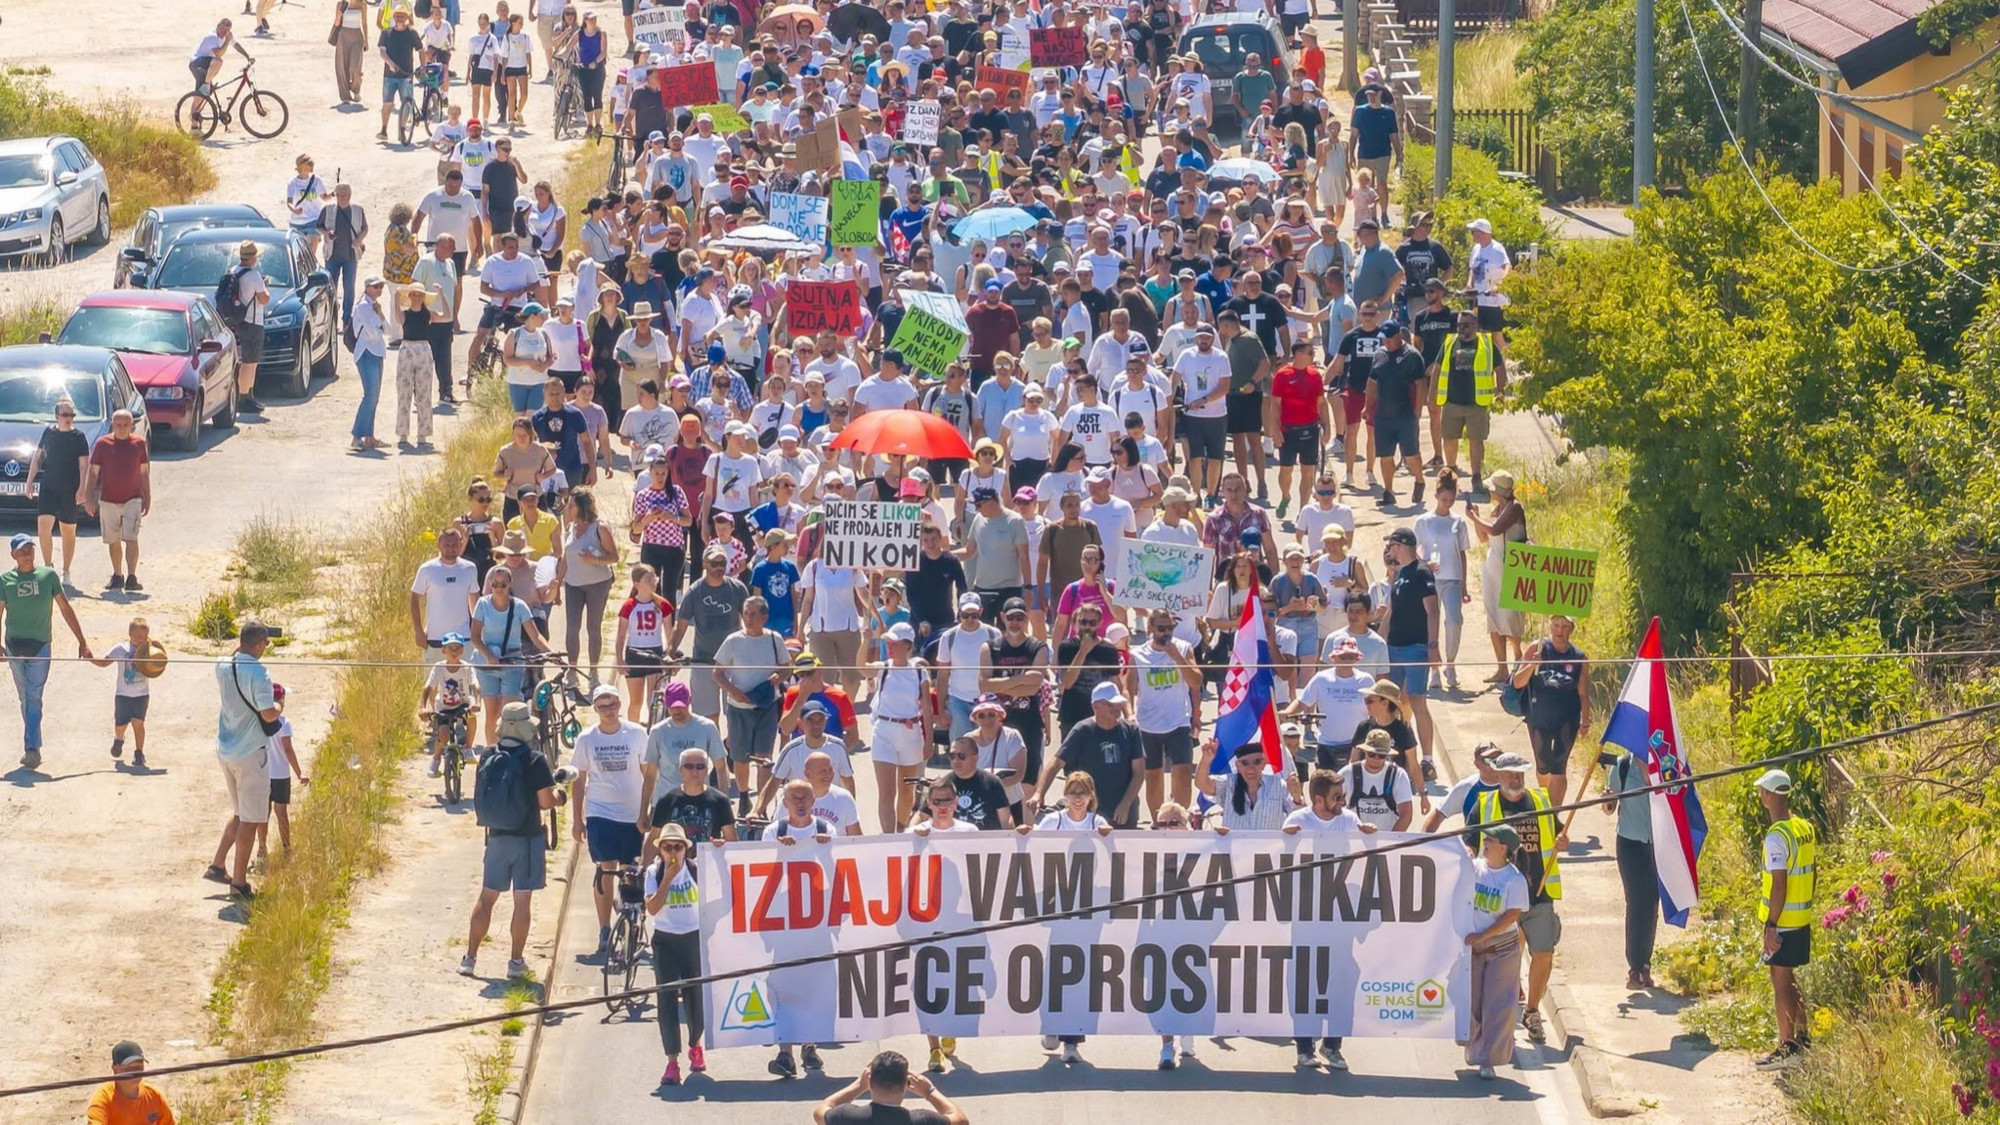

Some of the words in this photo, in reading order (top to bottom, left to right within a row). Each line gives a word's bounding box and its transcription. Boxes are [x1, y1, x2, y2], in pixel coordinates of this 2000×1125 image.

[772, 194, 797, 210] DOM
[805, 197, 826, 215] SE
[788, 209, 806, 225] NE
[836, 231, 878, 243] SLOBODA
[790, 311, 852, 333] IZDAJA
[908, 306, 963, 349] PRIRODA
[912, 330, 947, 356] NEMA
[1076, 423, 1090, 434] DO
[1079, 413, 1101, 423] JUST
[861, 503, 878, 520] SE
[883, 504, 921, 521] LIKOM
[824, 520, 839, 536] NE
[843, 521, 902, 538] PRODAJEM
[906, 522, 920, 540] JE
[825, 540, 918, 569] NIKOM
[1508, 548, 1538, 572] SVE
[1540, 554, 1596, 579] ANALIZE
[1512, 576, 1538, 604] NA
[636, 610, 657, 631] 19
[731, 854, 942, 934] IZDAJU
[965, 852, 1095, 923] VAM
[1109, 852, 1240, 922] LIKA
[1252, 853, 1437, 923] NIKAD
[1006, 943, 1331, 1015] OPROSTITI!
[1360, 979, 1416, 993] GOSPIĆ
[1365, 994, 1381, 1006] JE
[1385, 993, 1415, 1007] NAŠ
[1379, 1008, 1415, 1020] DOM
